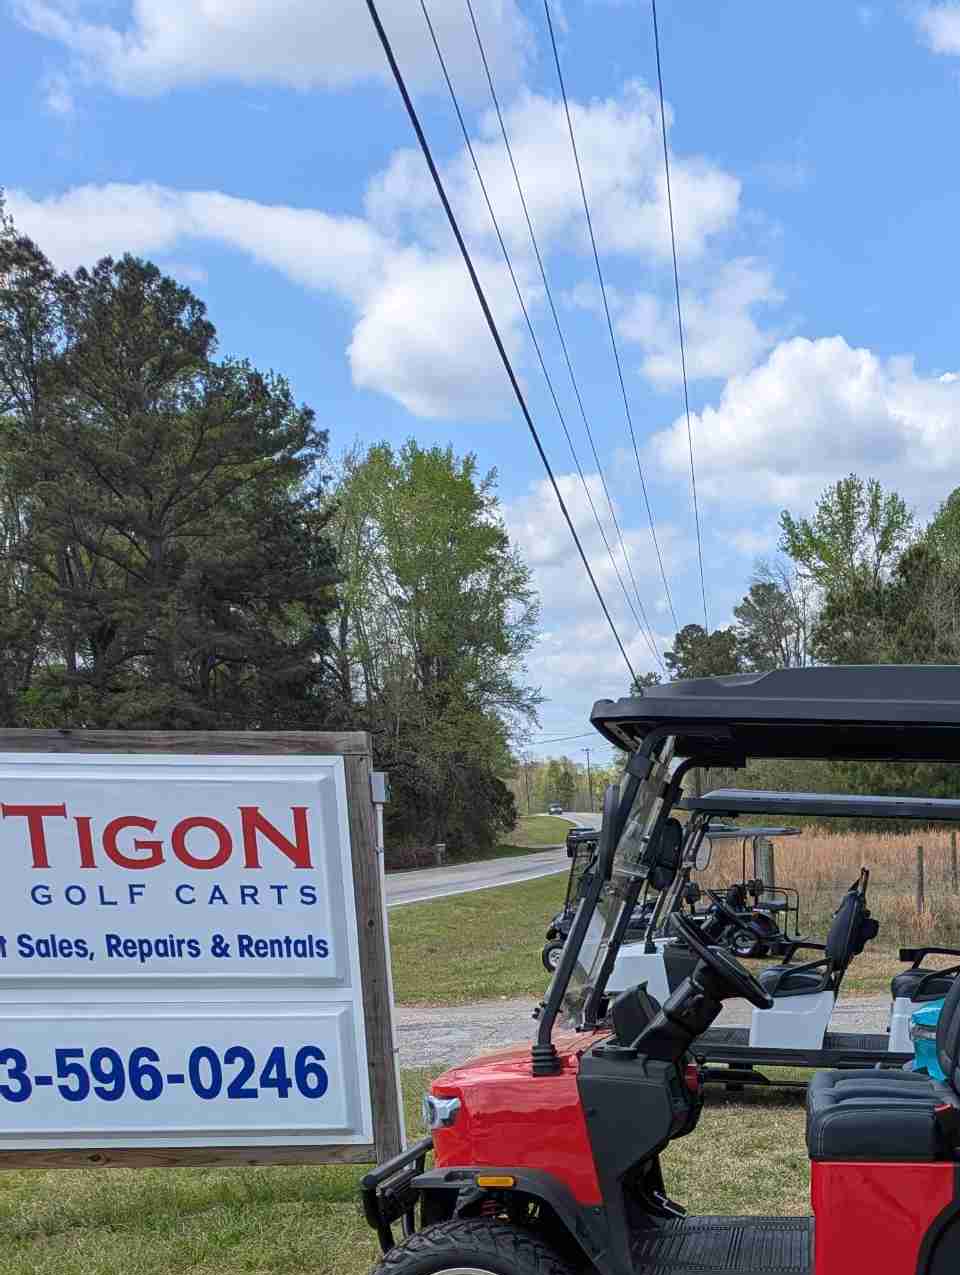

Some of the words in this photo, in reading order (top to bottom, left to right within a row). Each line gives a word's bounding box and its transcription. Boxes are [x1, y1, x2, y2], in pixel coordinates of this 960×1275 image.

[0, 802, 315, 870] TIGON
[30, 883, 147, 906] GOLF
[175, 883, 318, 906] CARTS
[16, 933, 95, 961] Sales,
[104, 933, 202, 963] Repairs
[210, 933, 232, 959] &
[236, 933, 330, 959] Rentals
[0, 1045, 330, 1103] 3-596-0246
